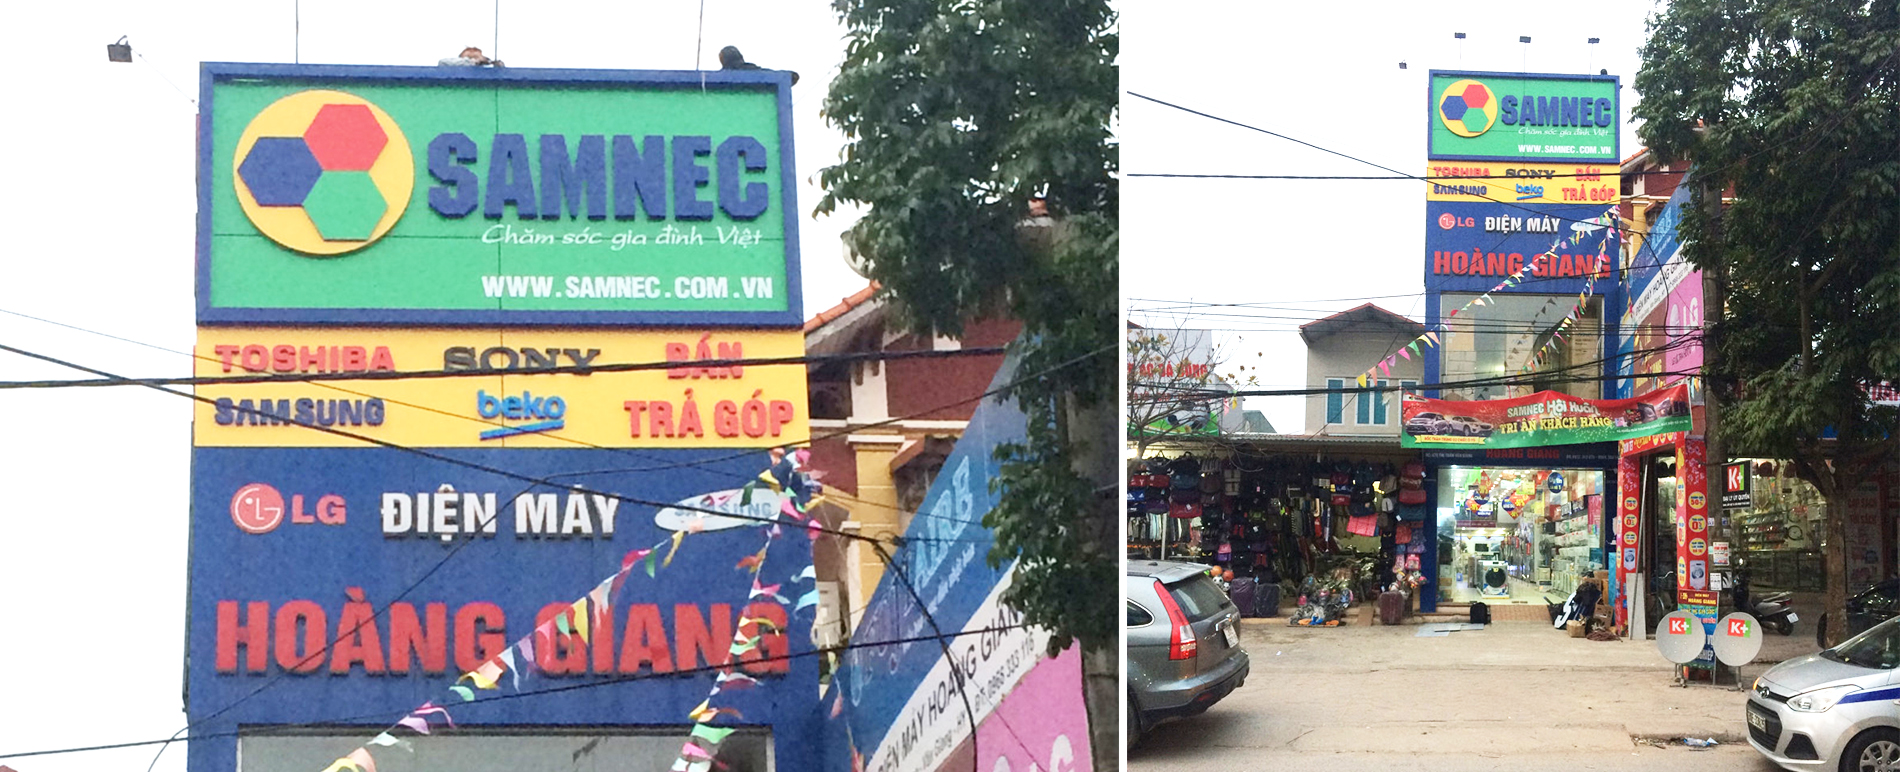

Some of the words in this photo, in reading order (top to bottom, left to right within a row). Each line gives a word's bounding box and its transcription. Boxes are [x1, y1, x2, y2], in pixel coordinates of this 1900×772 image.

[1501, 95, 1611, 128] SAMNEC
[427, 132, 768, 221] SAMNEC
[1433, 167, 1490, 177] TOSHIBA
[1505, 168, 1556, 179] SONY
[1576, 165, 1601, 181] BÁN
[1434, 185, 1487, 195] SAMSUNG
[1516, 183, 1544, 194] beko
[1562, 184, 1587, 201] TRẢ
[1590, 184, 1616, 201] GÓP
[1457, 217, 1475, 228] LG
[1485, 214, 1523, 234] ĐIỆN
[1526, 214, 1561, 232] MÁY
[481, 224, 555, 246] Chăm
[561, 225, 605, 246] sóc
[611, 228, 649, 250] gia
[655, 225, 704, 247] đình
[717, 225, 764, 249] Việt
[1434, 247, 1524, 277] HOÀNG
[1532, 252, 1611, 279] GIANG
[214, 344, 396, 375] TOSHIBA
[442, 345, 602, 376] SONY
[665, 332, 745, 379] BÁN
[214, 397, 386, 427] SAMSUNG
[476, 390, 567, 420] beko
[623, 388, 703, 438] TRẢ
[713, 389, 795, 439] GÓP
[1507, 402, 1544, 418] SAMNEC
[1500, 421, 1519, 434] TRI
[1520, 418, 1537, 432] ÂN
[1540, 416, 1577, 430] KHÁCH
[1580, 415, 1612, 427] HÀNG
[1527, 448, 1560, 459] GIANG
[1728, 467, 1743, 490] K+
[291, 495, 347, 525] LG
[380, 484, 498, 544] ĐIỆN
[514, 484, 621, 538] MÁY
[214, 586, 507, 676] HOÀNG
[534, 601, 791, 677] GIANG
[1671, 620, 1690, 632] K+
[1730, 621, 1749, 635] K+
